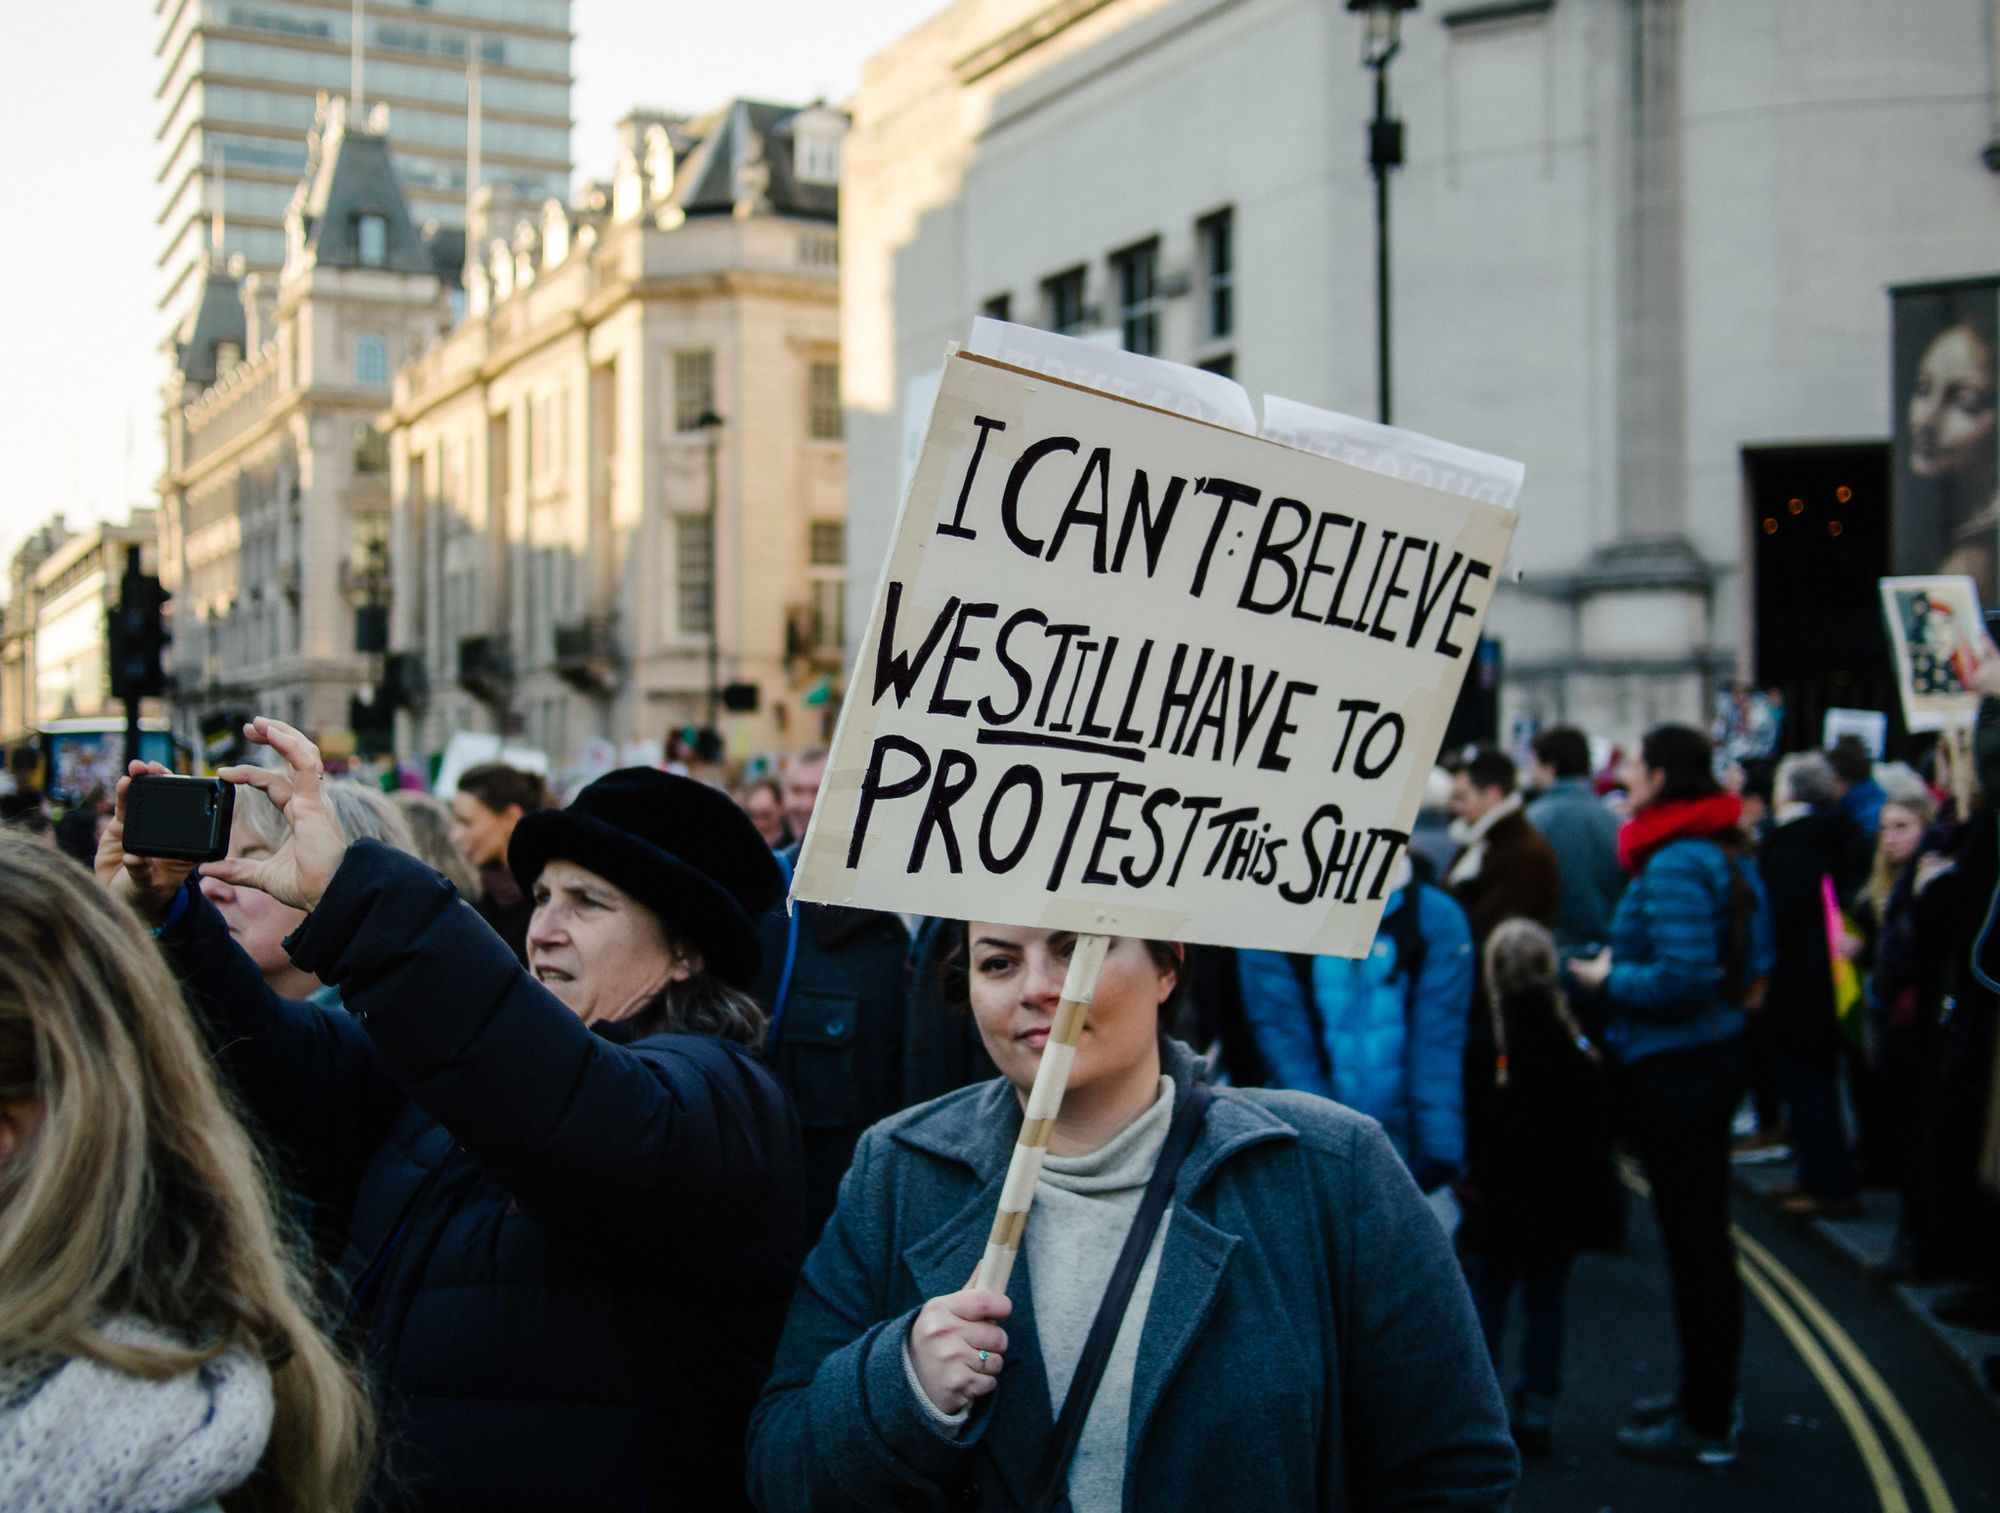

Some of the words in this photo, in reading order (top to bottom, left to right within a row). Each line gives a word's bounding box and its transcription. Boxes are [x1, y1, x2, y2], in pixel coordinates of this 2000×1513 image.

[935, 415, 1006, 541] I
[1236, 497, 1493, 660] BELIEVE
[872, 581, 999, 718] WE
[977, 608, 1154, 745] STILL
[1148, 643, 1318, 773] HAVE
[1332, 699, 1405, 780] TO
[846, 735, 1223, 892] PROTEST
[1278, 803, 1410, 905] SHIT
